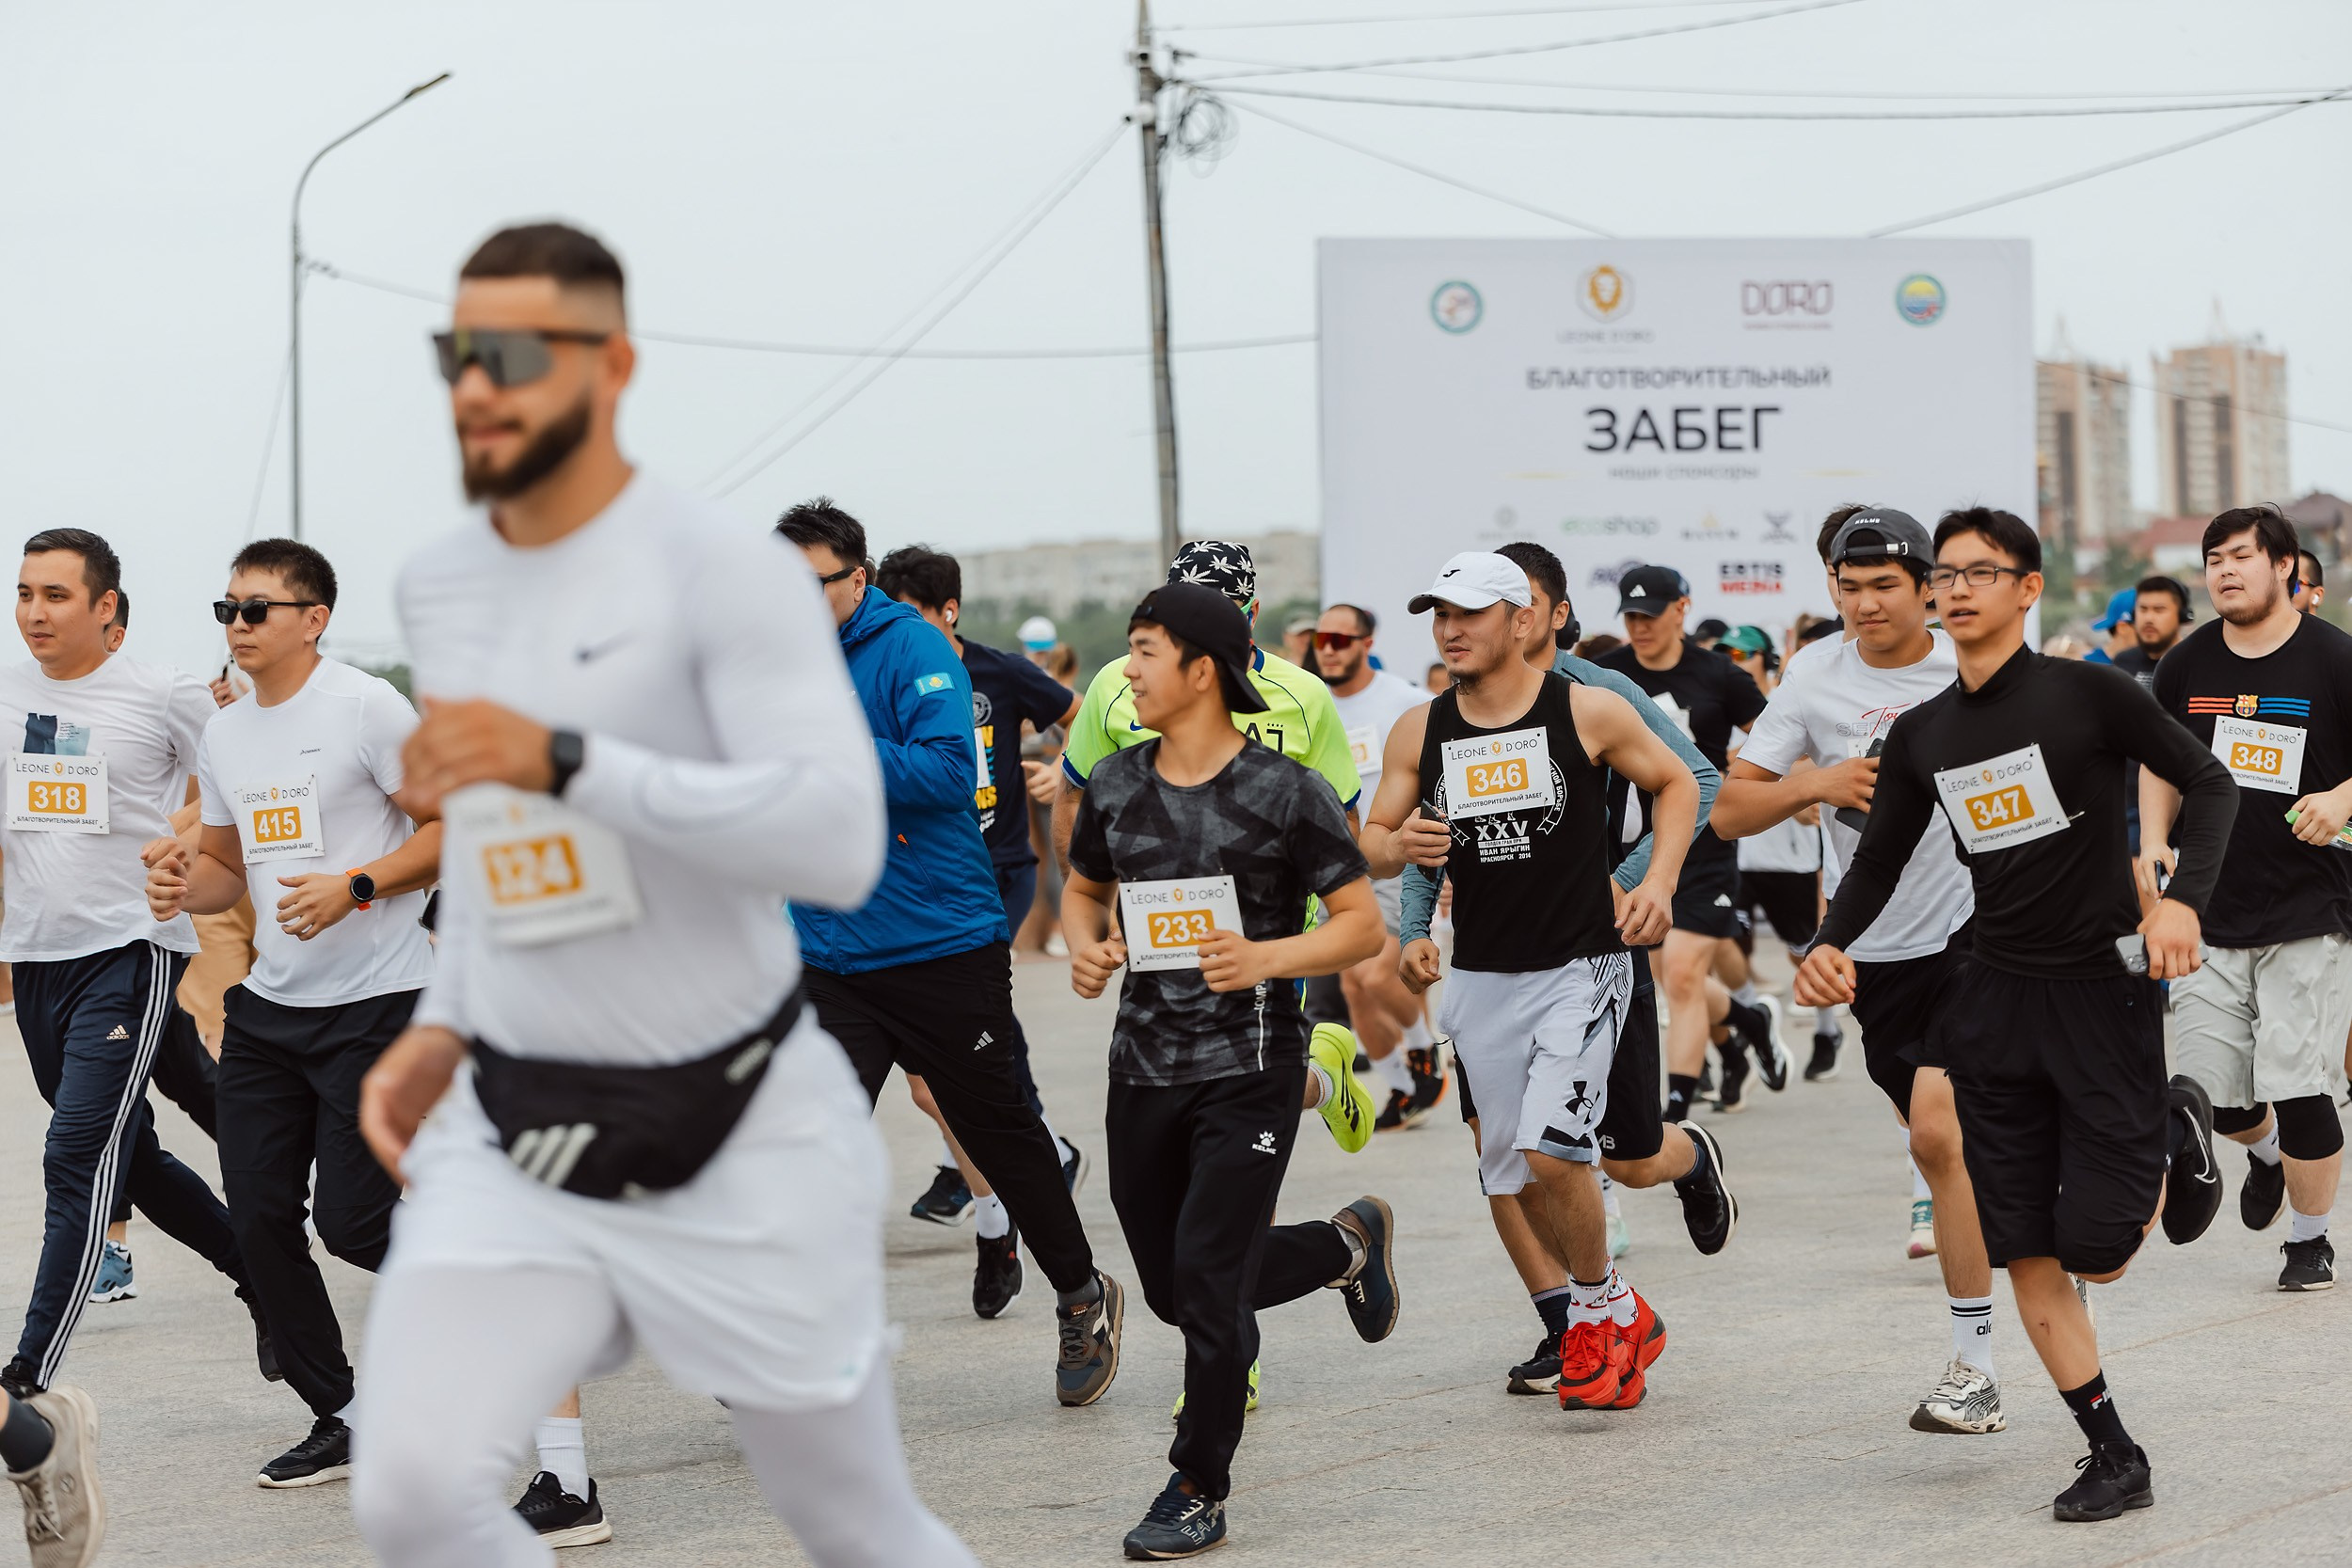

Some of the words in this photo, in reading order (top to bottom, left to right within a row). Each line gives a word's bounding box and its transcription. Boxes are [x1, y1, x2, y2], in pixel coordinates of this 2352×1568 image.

[1740, 279, 1835, 316] DORO
[1526, 362, 1832, 391] БЛАГОТВОРИТЕЛЬНЫЙ
[1584, 405, 1784, 453] ЗАБЕГ
[2223, 726, 2253, 737] LEONE
[2269, 733, 2296, 744] D'ORO
[1451, 747, 1487, 760] LEONE
[1506, 738, 1537, 752] D'ORO
[2235, 747, 2277, 771] 348
[16, 763, 50, 774] LEONE
[68, 766, 99, 776] D'ORO
[1473, 763, 1522, 792] 346
[1946, 777, 1979, 793] LEONE
[1996, 760, 2032, 780] D'ORO
[34, 784, 81, 811] 318
[243, 792, 267, 804] LEONE
[282, 787, 310, 799] D'ORO
[1458, 794, 1524, 810] БЛАГОТВОРИТЕЛЬНЫЙ
[1525, 792, 1543, 800] ЗАБЕГ
[1973, 790, 2020, 826] 347
[17, 816, 81, 825] БЛАГОТВОРИТЕЛЬНЫЙ
[258, 811, 296, 838] 415
[1970, 822, 2033, 845] БЛАГОТВОРИТЕЛЬНЫЙ
[2034, 816, 2053, 828] ЗАБЕГ
[248, 843, 298, 855] БЛАГОТВОРИТЕЛЬНЫЙ
[1480, 853, 1514, 863] КРАСНОЯРСК
[1500, 845, 1530, 854] ЯРЫГИН
[1131, 893, 1168, 905] LEONE
[1189, 888, 1224, 901] D'ORO
[1154, 913, 1209, 943] 233
[1140, 951, 1200, 961] БЛАГОТВОРИТЕЛЬ
